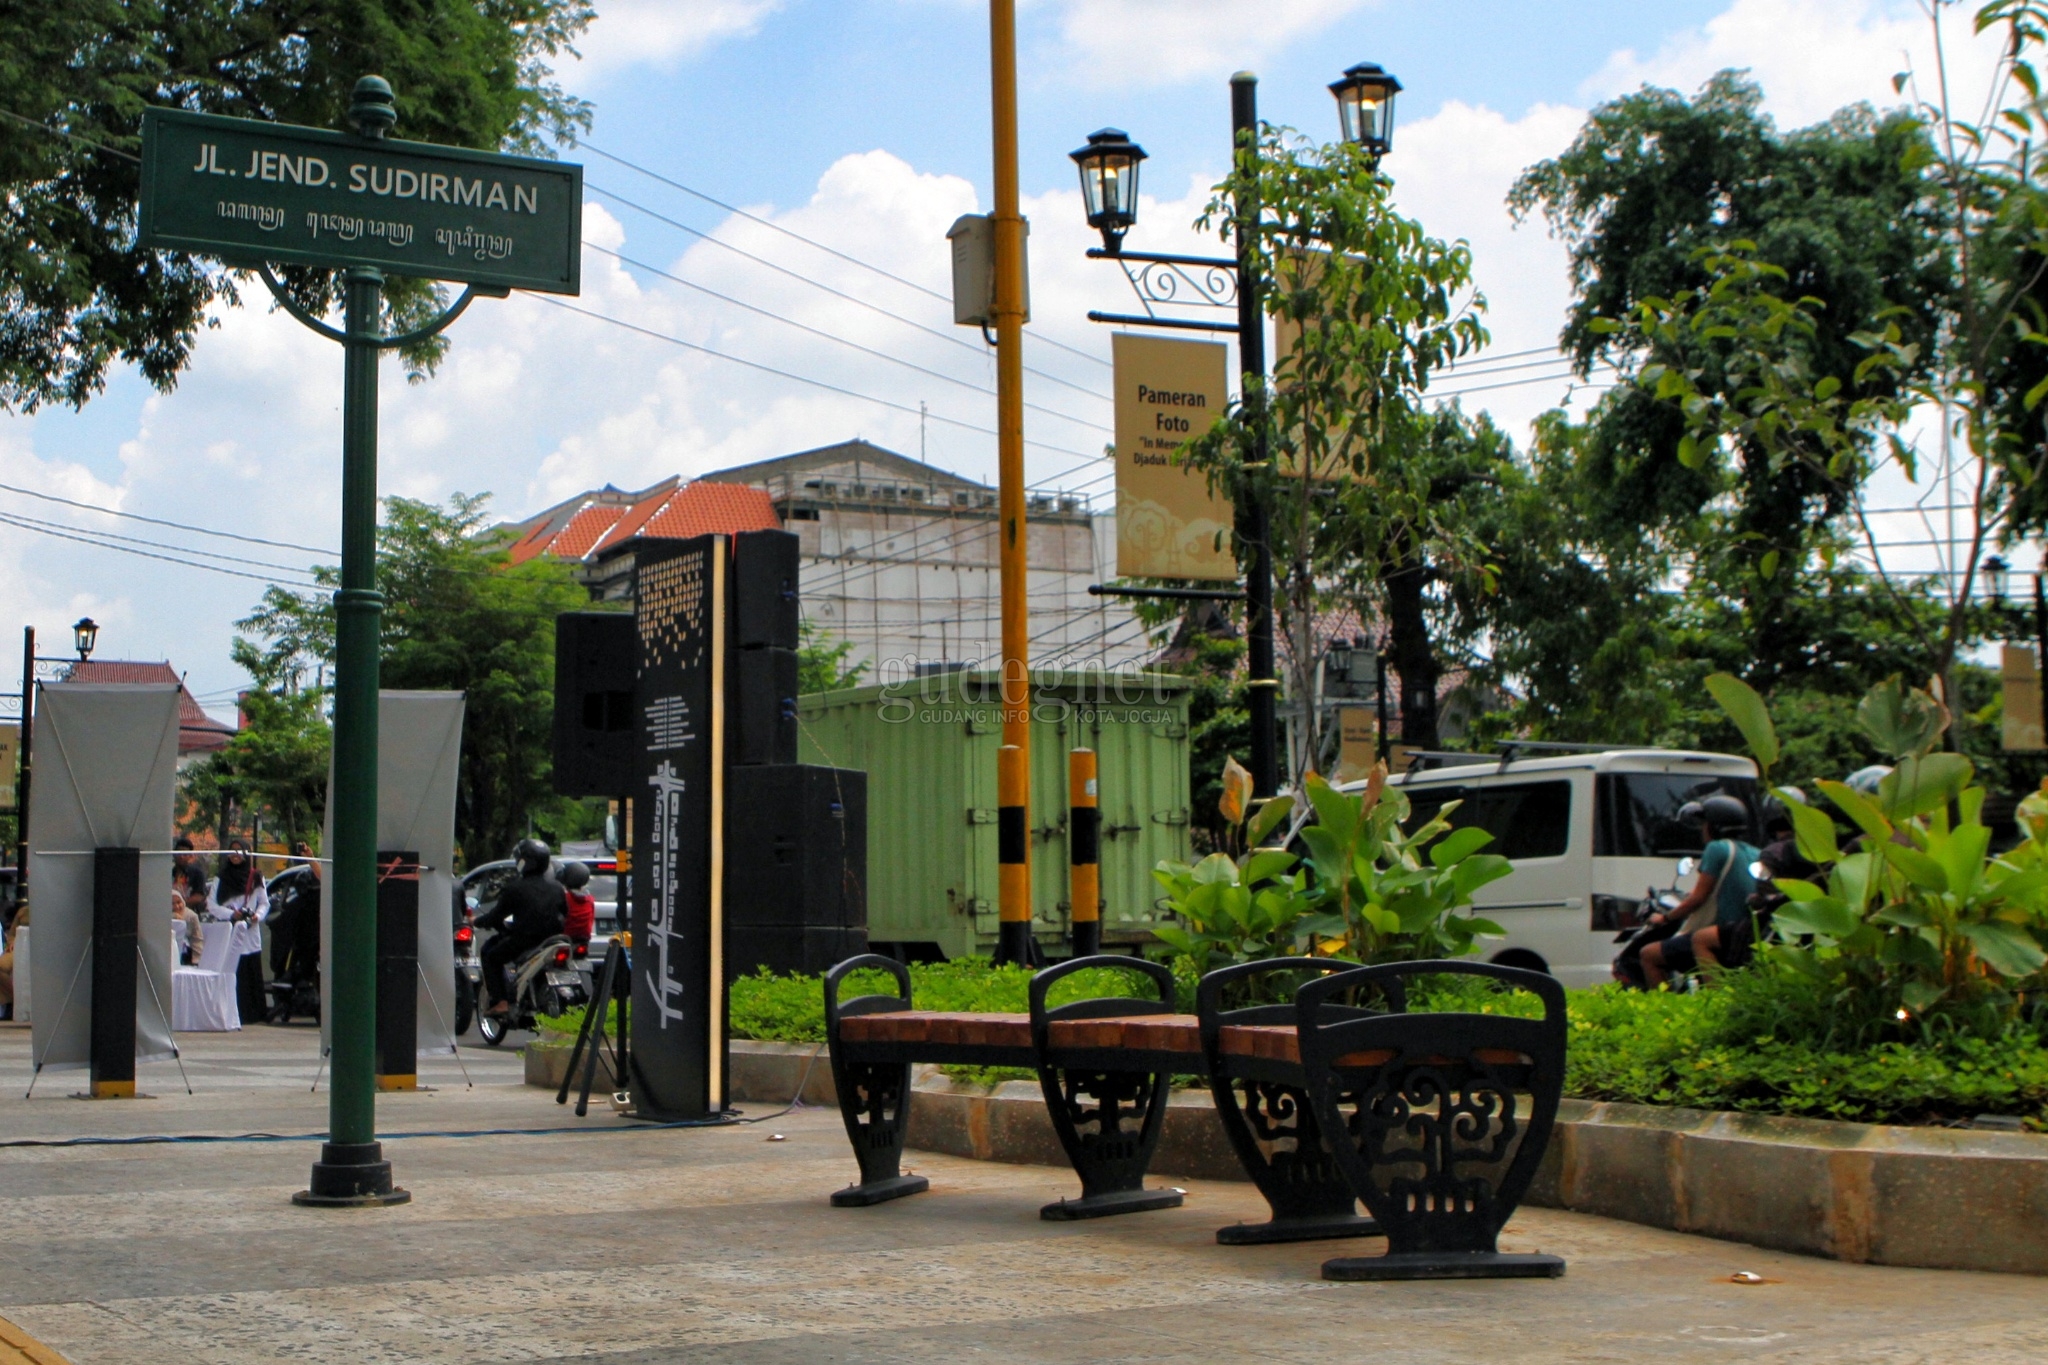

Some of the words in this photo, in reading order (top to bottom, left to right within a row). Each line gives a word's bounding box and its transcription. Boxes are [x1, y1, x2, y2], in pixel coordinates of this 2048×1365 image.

[194, 143, 236, 177] JL.
[245, 150, 337, 189] JEND.
[349, 163, 538, 214] SUDIRMAN
[1138, 384, 1206, 407] Pameran
[1156, 413, 1189, 432] Foto
[1133, 452, 1167, 467] Djaduk
